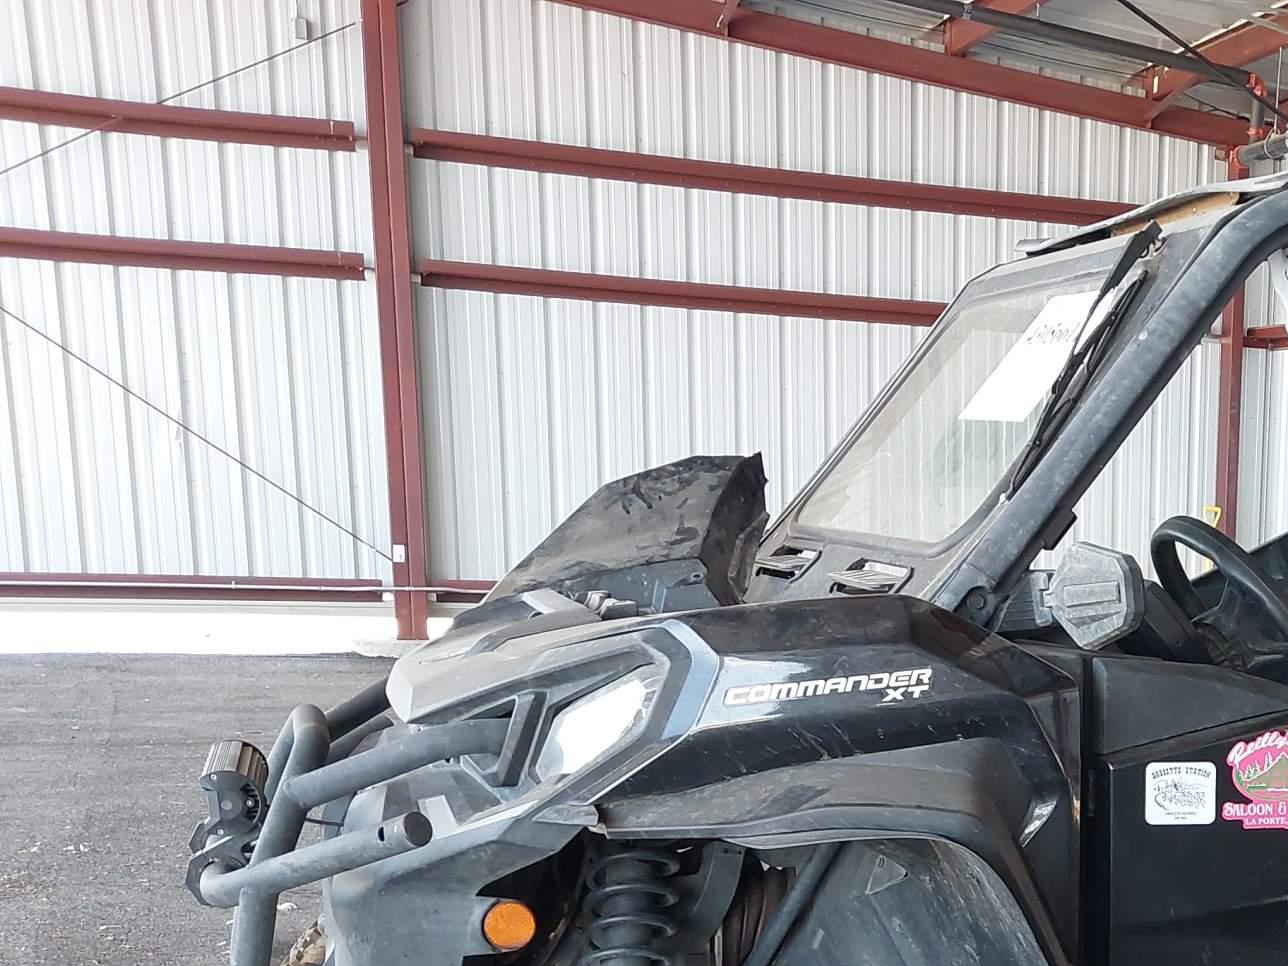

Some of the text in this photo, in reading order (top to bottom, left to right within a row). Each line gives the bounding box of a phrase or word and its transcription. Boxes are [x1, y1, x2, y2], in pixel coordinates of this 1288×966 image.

[725, 668, 933, 705] COMMANDER
[882, 685, 929, 703] XT
[1223, 802, 1273, 816] SALOON
[1278, 801, 1287, 816] &
